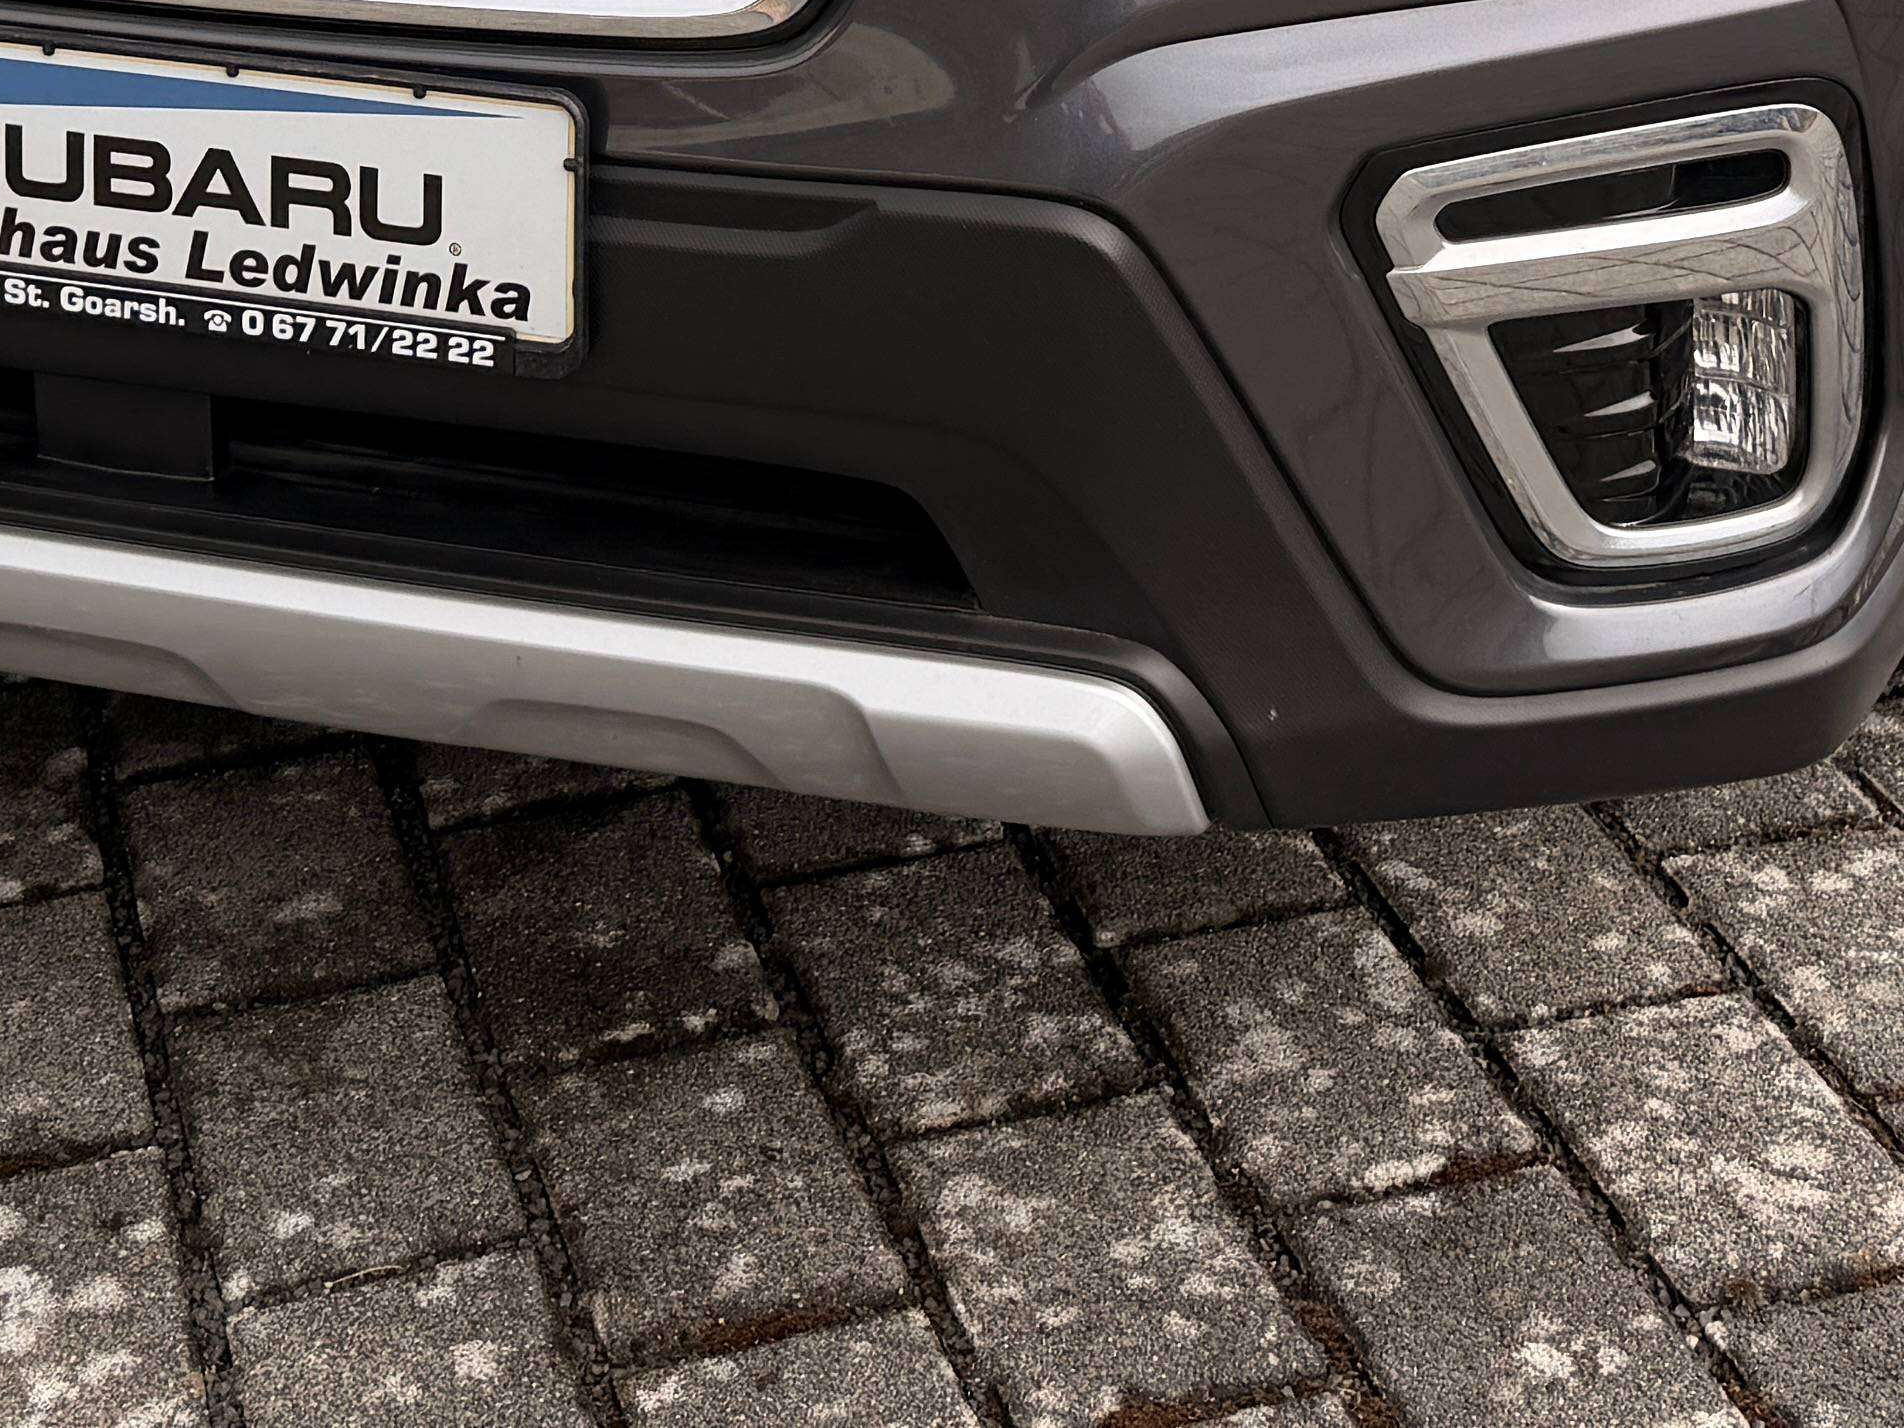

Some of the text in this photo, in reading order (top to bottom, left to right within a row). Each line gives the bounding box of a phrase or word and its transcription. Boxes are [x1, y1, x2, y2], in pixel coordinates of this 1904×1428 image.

[3, 278, 50, 309] St.
[59, 286, 186, 327] Goarsh.
[185, 229, 533, 323] Ledwinka
